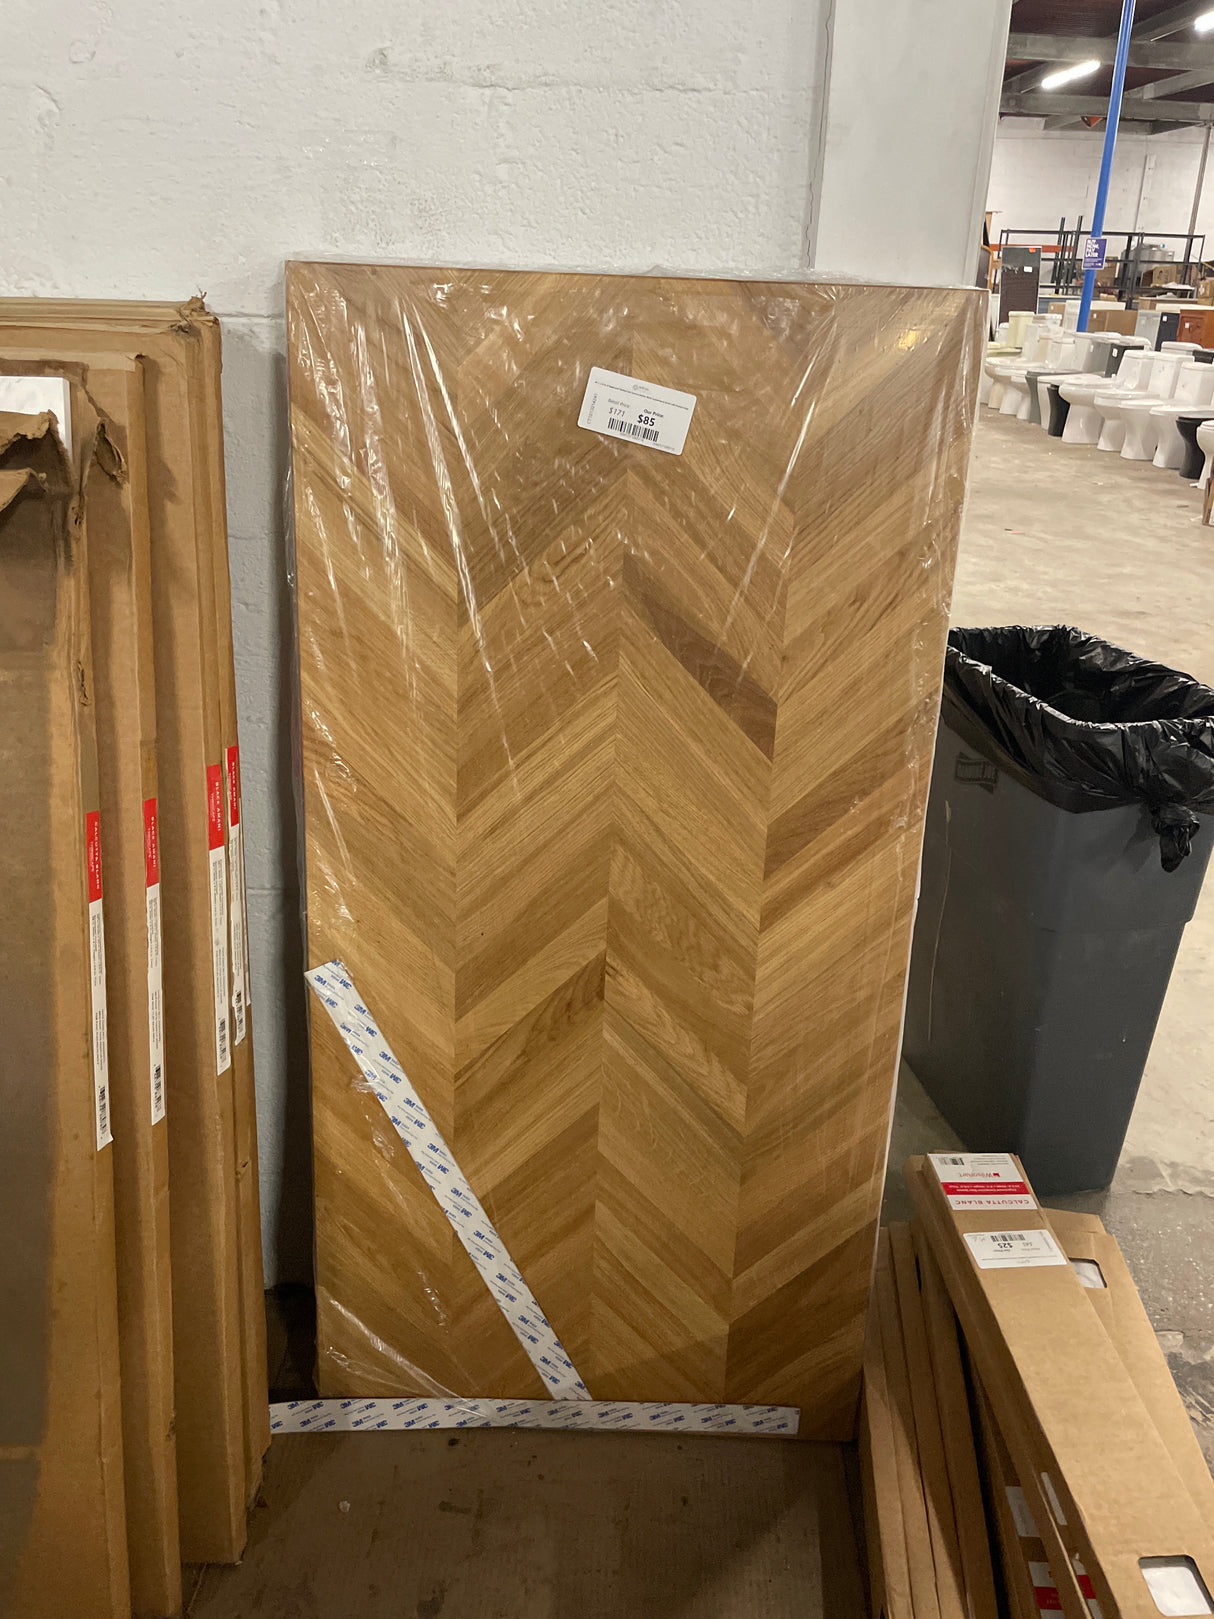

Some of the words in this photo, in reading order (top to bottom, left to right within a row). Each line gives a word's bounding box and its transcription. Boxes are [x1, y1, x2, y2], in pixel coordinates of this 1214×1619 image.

[608, 407, 626, 417] $171
[637, 414, 656, 427] $85
[314, 975, 327, 985] 3M
[354, 1004, 366, 1014] 3M
[379, 1051, 392, 1061] 3M
[404, 1098, 415, 1108] 3M
[427, 1143, 439, 1153] 3M
[451, 1187, 462, 1197] 3M
[474, 1230, 485, 1240] 3M
[496, 1273, 507, 1283] 3M
[518, 1315, 529, 1324] 3M
[539, 1356, 551, 1365] 3M
[575, 1381, 585, 1390] 3M
[288, 1401, 299, 1409] 3M
[341, 1401, 352, 1409] 3M
[393, 1401, 404, 1410] 3M
[496, 1404, 508, 1413] 3M
[547, 1408, 558, 1416] 3M
[598, 1410, 610, 1418] 3M
[649, 1413, 661, 1421] 3M
[701, 1416, 713, 1424] 3M
[300, 1419, 311, 1427] 3M
[352, 1419, 363, 1427] 3M
[404, 1419, 415, 1428] 3M
[456, 1419, 467, 1427] 3M
[753, 1420, 764, 1428] 3M
